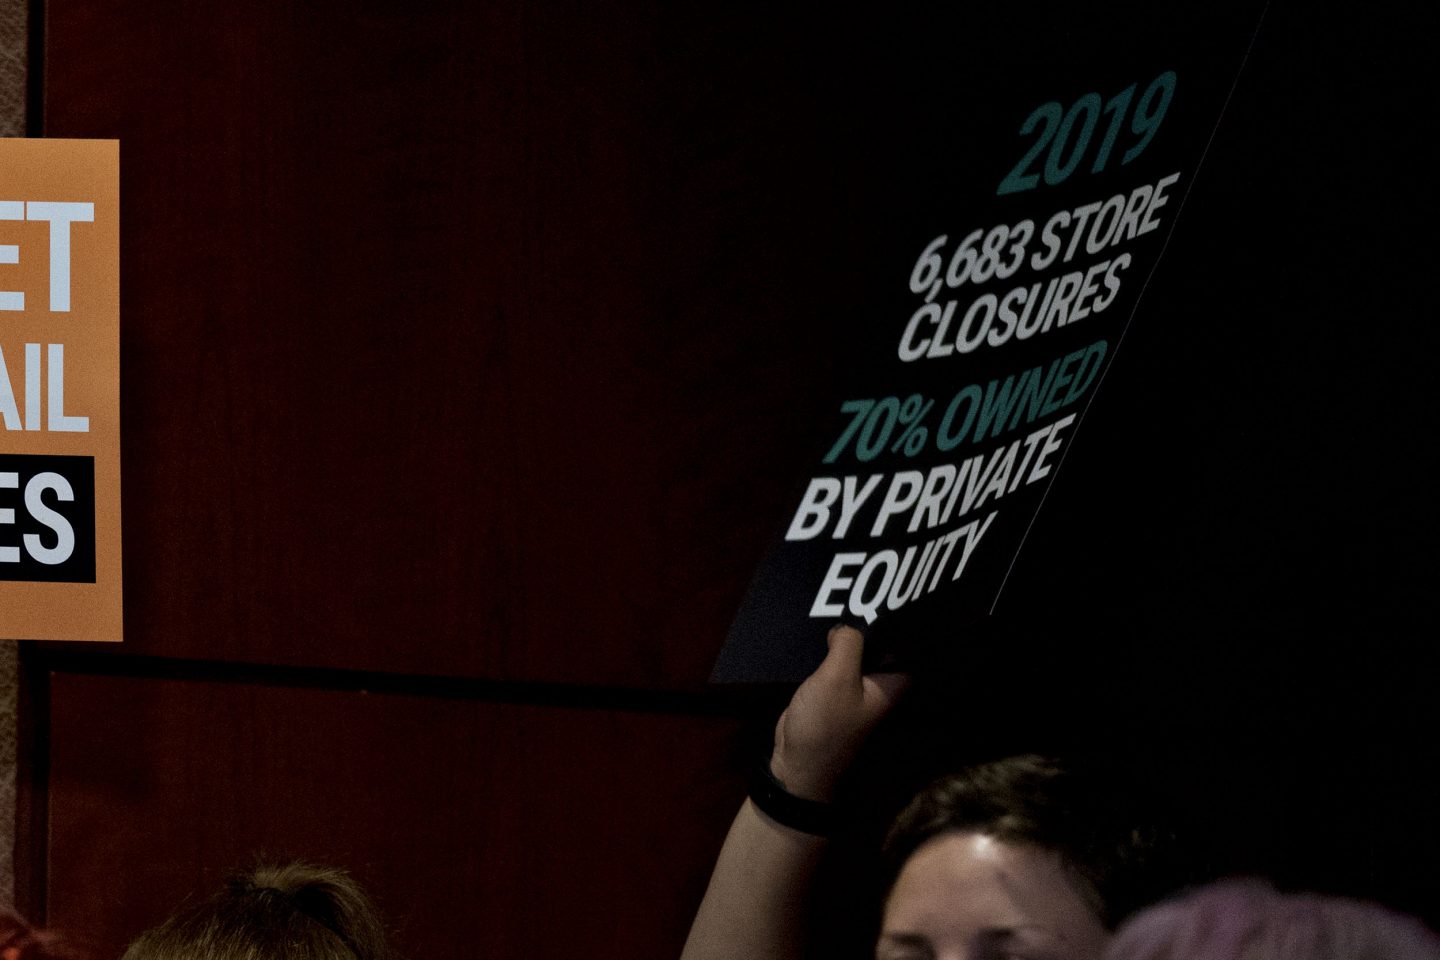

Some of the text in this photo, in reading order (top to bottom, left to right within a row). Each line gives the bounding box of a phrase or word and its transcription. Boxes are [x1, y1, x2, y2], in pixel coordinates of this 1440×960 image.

[995, 69, 1179, 197] 2019
[909, 171, 1181, 303] 6,683 STORE
[897, 252, 1132, 364] CLOSURES
[820, 339, 1109, 466] 70% OWNED
[784, 413, 1077, 543] BY PRIVATE
[808, 509, 999, 625] EQUITY
